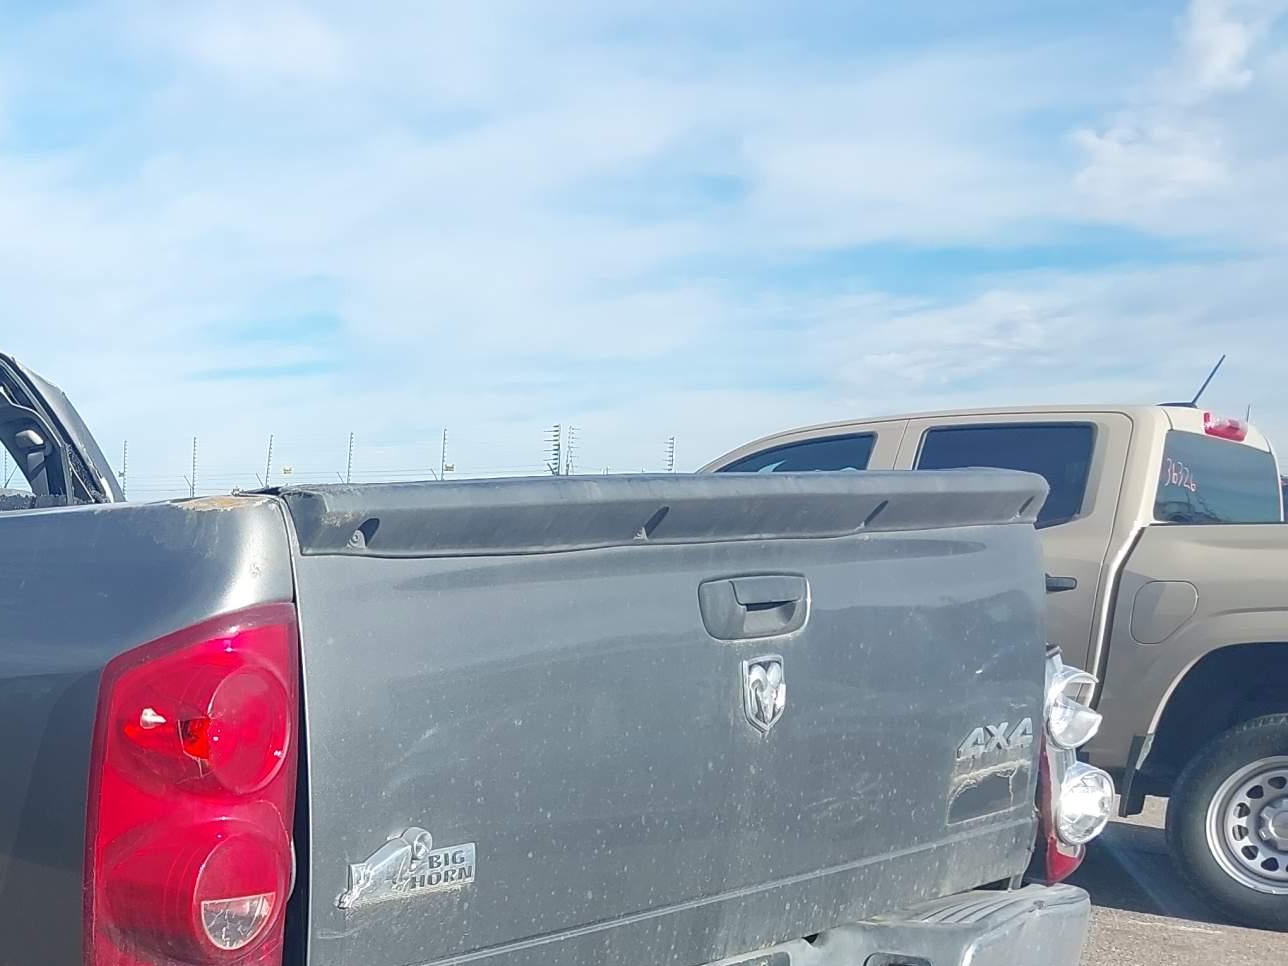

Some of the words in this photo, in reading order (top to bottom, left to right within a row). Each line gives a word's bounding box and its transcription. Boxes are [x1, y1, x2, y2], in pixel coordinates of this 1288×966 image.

[956, 717, 1033, 760] 4X4
[428, 849, 465, 870] BIG
[409, 865, 473, 890] HORN
